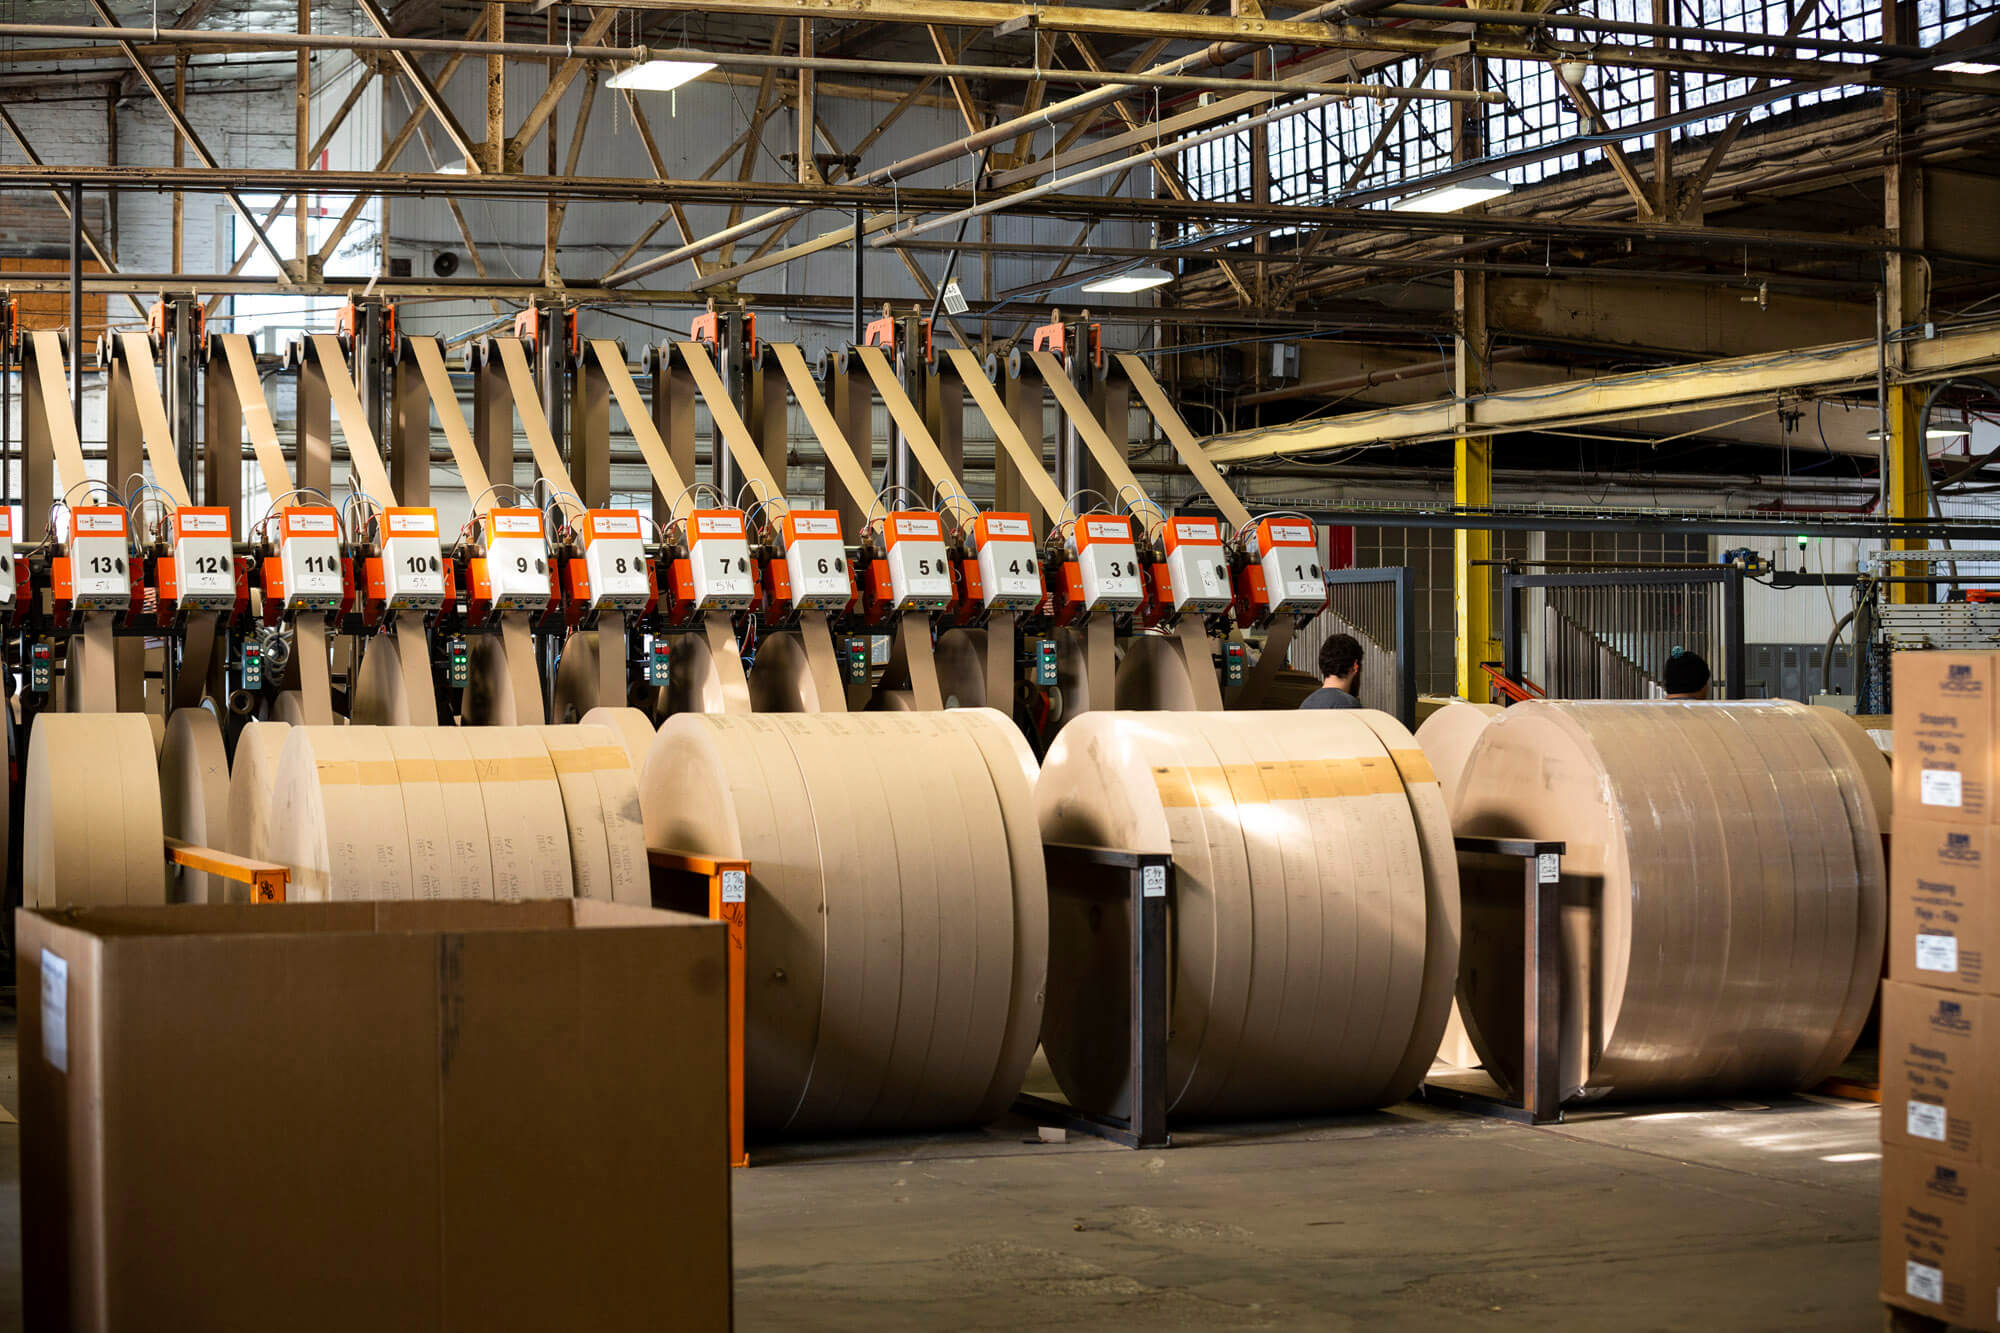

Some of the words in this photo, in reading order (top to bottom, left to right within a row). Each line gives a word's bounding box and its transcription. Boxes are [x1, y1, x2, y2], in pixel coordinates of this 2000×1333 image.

[90, 556, 112, 574] 13
[195, 557, 218, 574] 12
[304, 556, 324, 573] 11
[406, 556, 427, 573] 10
[516, 557, 528, 573] 9
[615, 558, 627, 574] 8
[719, 558, 730, 575] 7
[817, 558, 829, 574] 6
[919, 559, 930, 576] 5
[1009, 559, 1021, 576] 4
[1110, 561, 1121, 578] 3
[1294, 564, 1304, 581] 1
